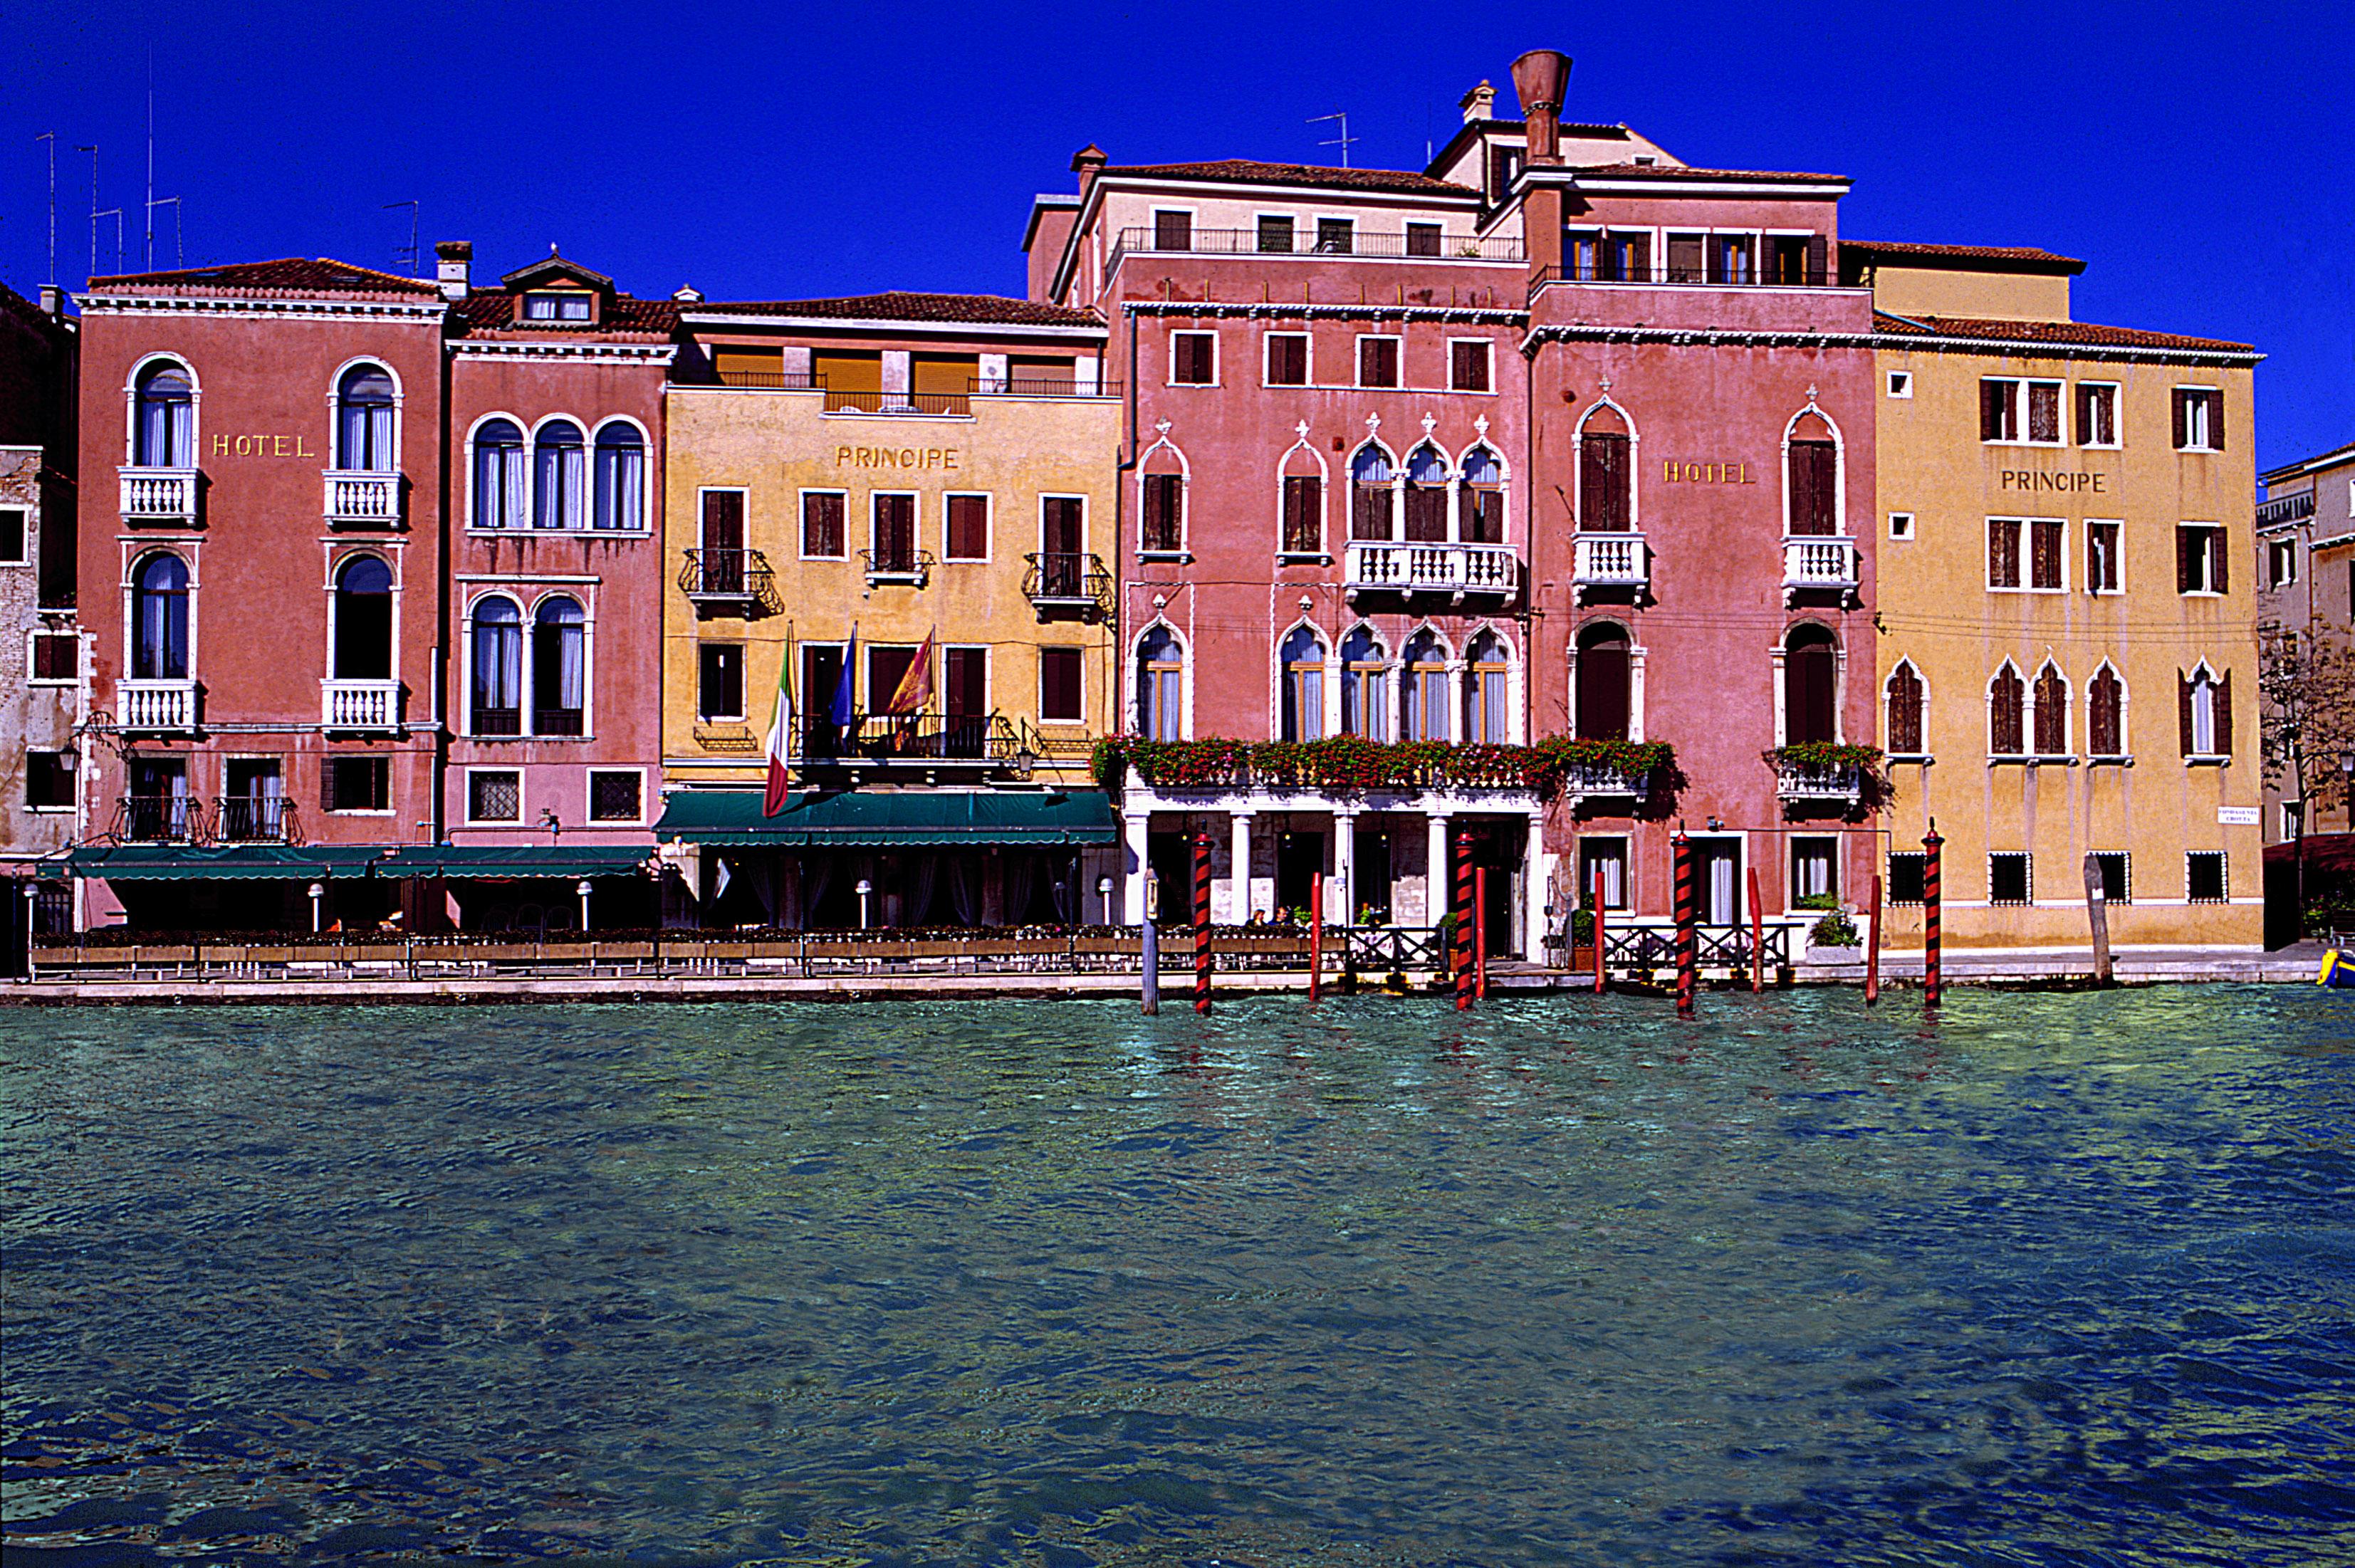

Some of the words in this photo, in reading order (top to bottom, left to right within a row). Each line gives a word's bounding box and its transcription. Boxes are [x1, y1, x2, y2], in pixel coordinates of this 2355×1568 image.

[214, 434, 315, 457] HOTEL
[835, 446, 959, 469] PRINCIPE
[1664, 461, 1756, 484] HOTEL
[2001, 470, 2106, 493] PRINCIPE
